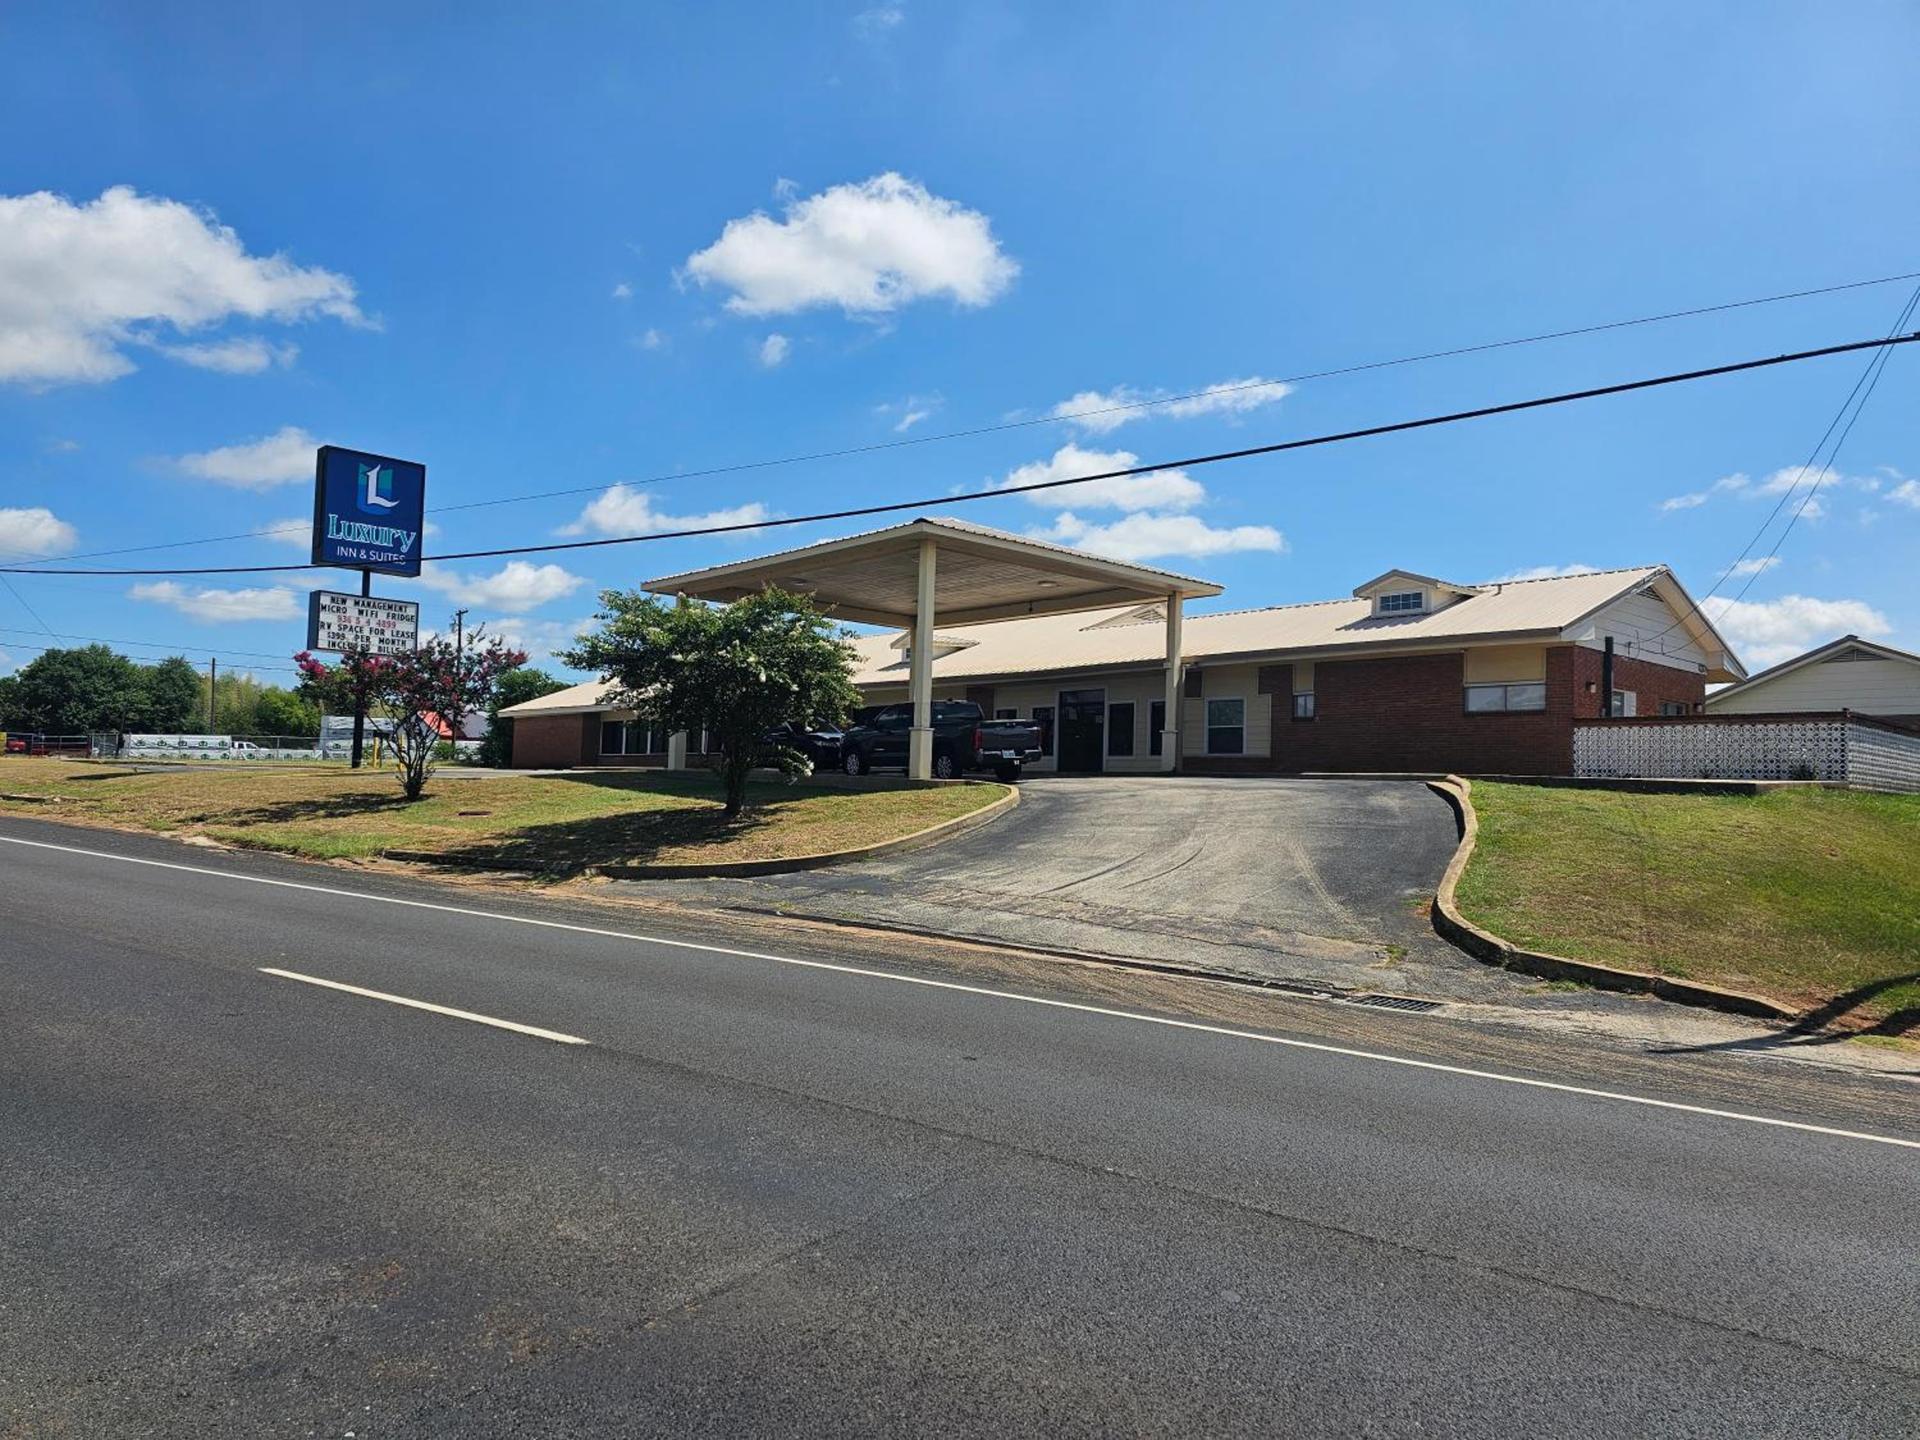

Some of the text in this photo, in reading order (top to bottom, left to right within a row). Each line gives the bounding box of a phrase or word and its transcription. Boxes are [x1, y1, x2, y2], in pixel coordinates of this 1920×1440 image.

[366, 464, 400, 508] L
[328, 514, 417, 554] Luxury
[337, 546, 406, 565] INN & SUITES
[320, 604, 415, 623] MICRO WIFI FRIDGE
[330, 596, 408, 612] NEW MANAGEMENT
[320, 621, 415, 640] RV SPACE FOR LEASE
[355, 634, 371, 643] PER
[379, 637, 406, 646] MONTH
[378, 646, 400, 655] BILLS
